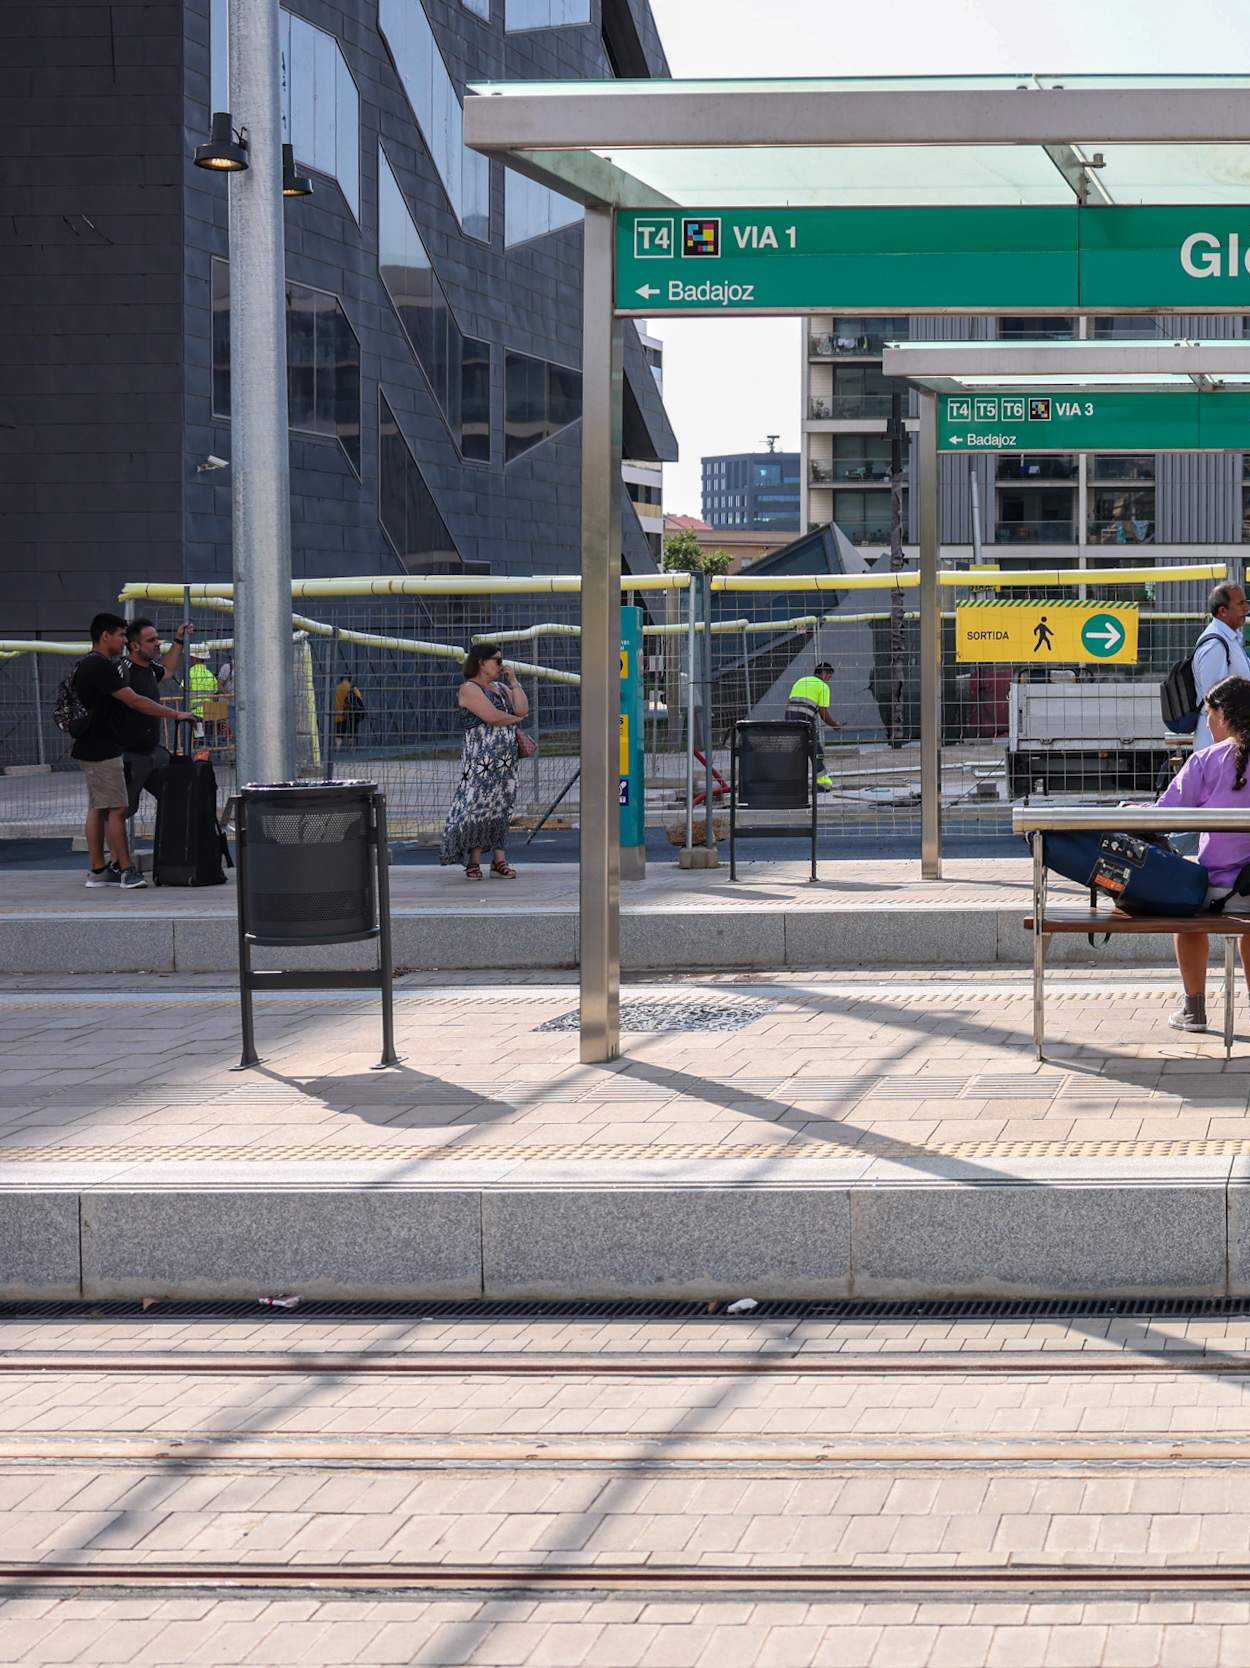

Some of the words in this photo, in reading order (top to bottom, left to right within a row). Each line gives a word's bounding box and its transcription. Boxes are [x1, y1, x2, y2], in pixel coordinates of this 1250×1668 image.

[638, 226, 671, 249] T4
[733, 226, 779, 249] VIA
[785, 226, 797, 249] 1
[668, 281, 754, 305] Badajoz
[950, 403, 968, 416] T4
[977, 403, 995, 416] T5
[1004, 403, 1022, 416] T6
[1056, 403, 1081, 416] VIA
[1084, 403, 1094, 416] 3
[968, 434, 1017, 448] Badajoz
[967, 631, 1009, 640] SORTIDA
